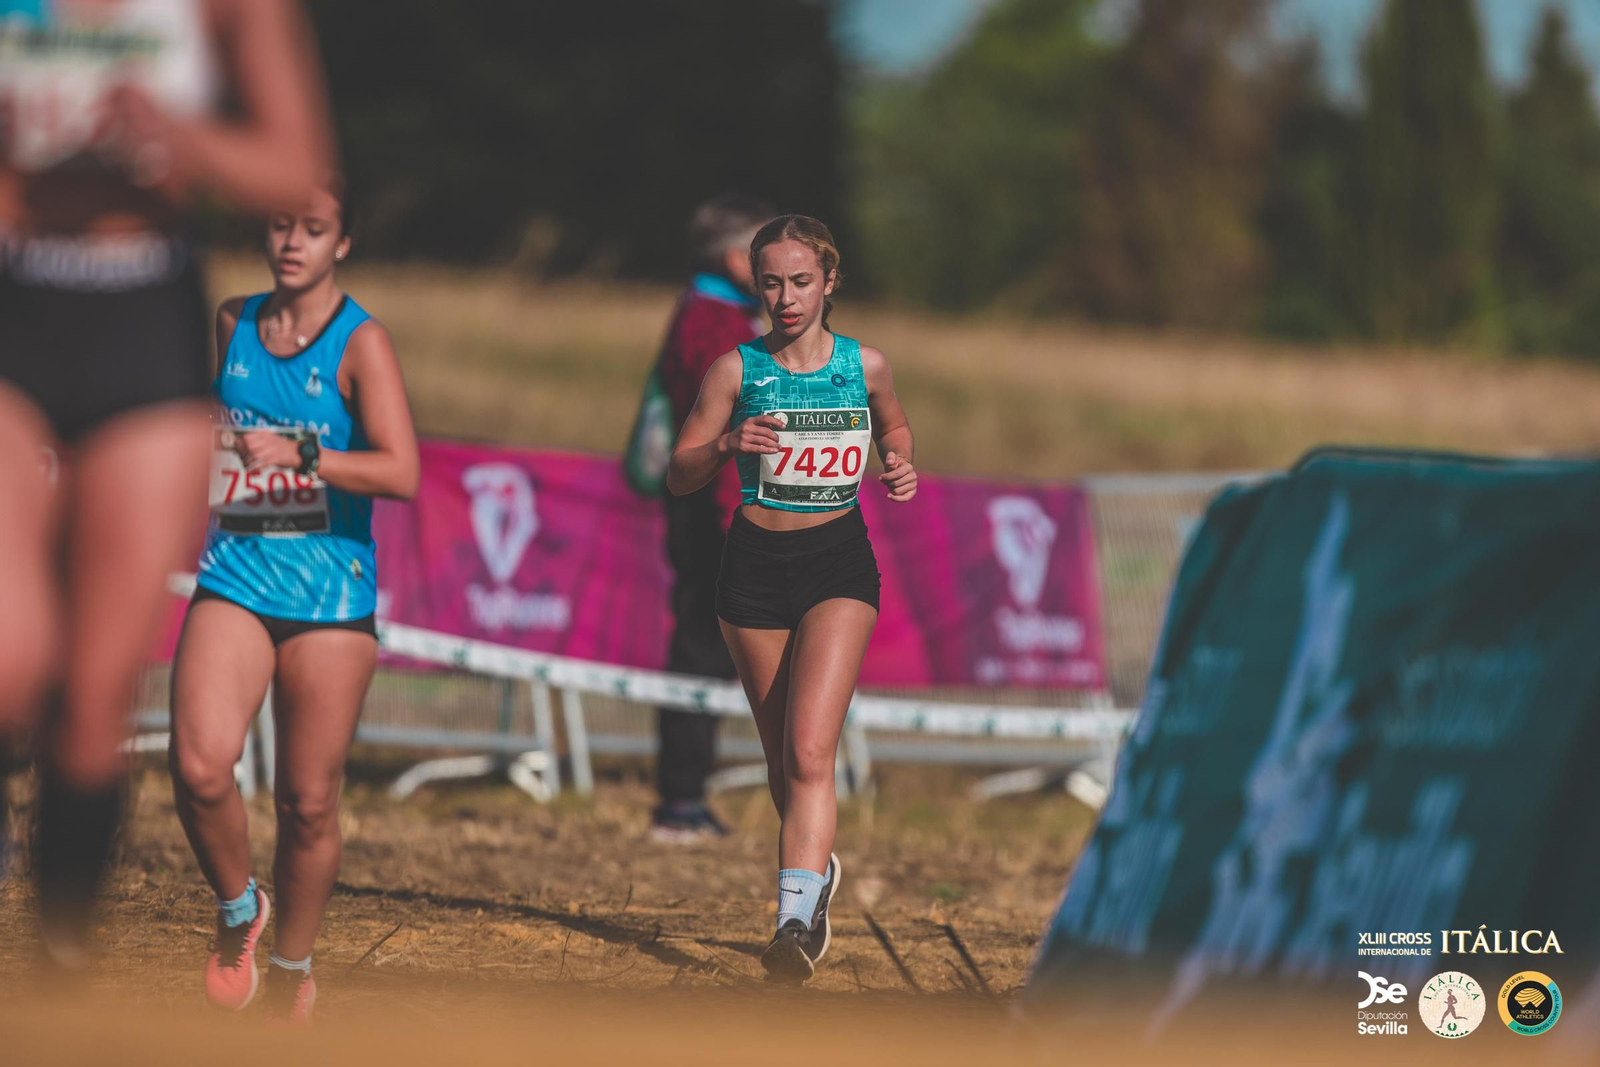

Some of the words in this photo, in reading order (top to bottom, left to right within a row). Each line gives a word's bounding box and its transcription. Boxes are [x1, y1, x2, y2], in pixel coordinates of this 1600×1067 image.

[795, 412, 845, 425] ITÁLICA
[773, 446, 862, 478] 7420
[221, 469, 319, 508] 7508
